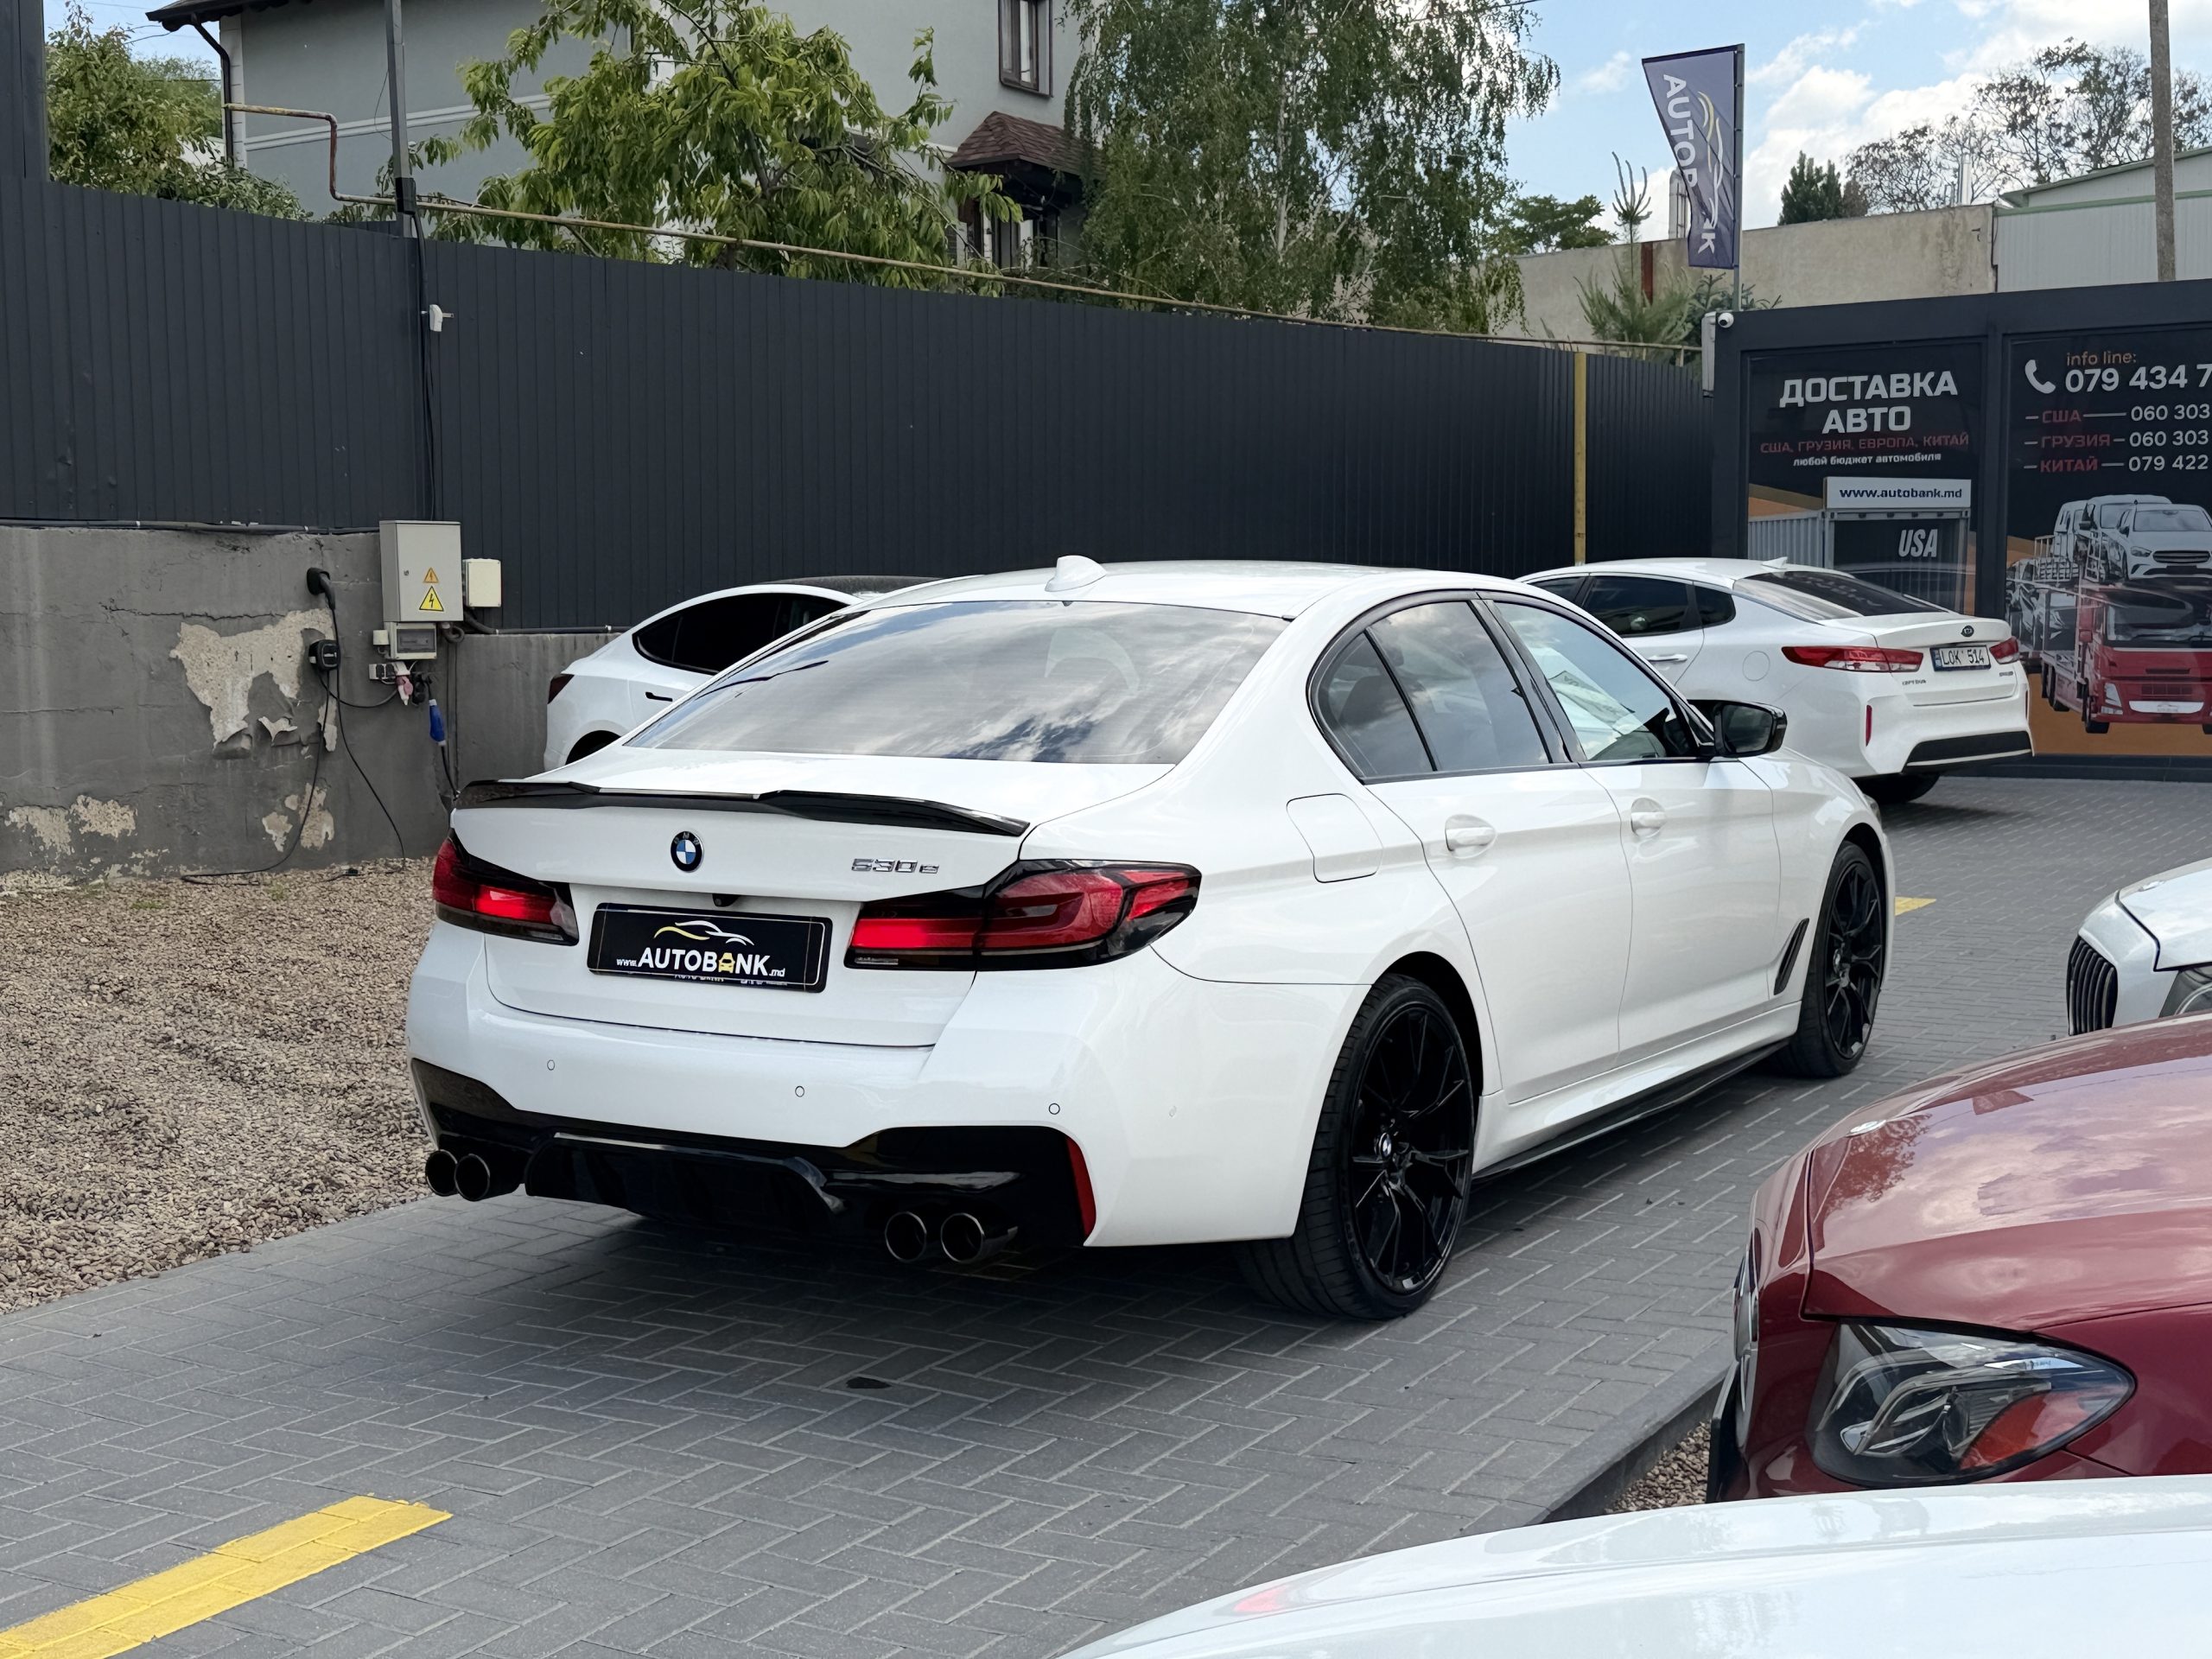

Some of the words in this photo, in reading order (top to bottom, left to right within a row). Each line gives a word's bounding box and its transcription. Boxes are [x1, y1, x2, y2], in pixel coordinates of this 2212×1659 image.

[2066, 351, 2098, 366] info
[2103, 350, 2137, 364] line:
[2065, 367, 2120, 393] 079
[2128, 364, 2189, 391] 434
[1779, 371, 1958, 408] ДОСТАВКА
[1821, 405, 1911, 434] АВТО
[2042, 410, 2082, 423] США
[2131, 404, 2169, 422] 060
[2173, 403, 2211, 420] 303
[1923, 432, 1969, 447] КИТАЙ
[2041, 434, 2111, 448] ГРУЗИЯ
[2129, 430, 2167, 448] 060
[2171, 429, 2209, 446] 303
[1793, 455, 1827, 467] любой
[1830, 454, 1872, 466] бюджет
[1875, 452, 1942, 464] автомобиля
[2040, 455, 2099, 473] КИТАЙ
[2128, 455, 2165, 472] 079
[2171, 454, 2209, 471] 422
[1840, 488, 1962, 499] www.autobank.md
[1897, 529, 1938, 557] USA
[1941, 650, 1961, 665] LOK
[1967, 649, 1985, 664] 514
